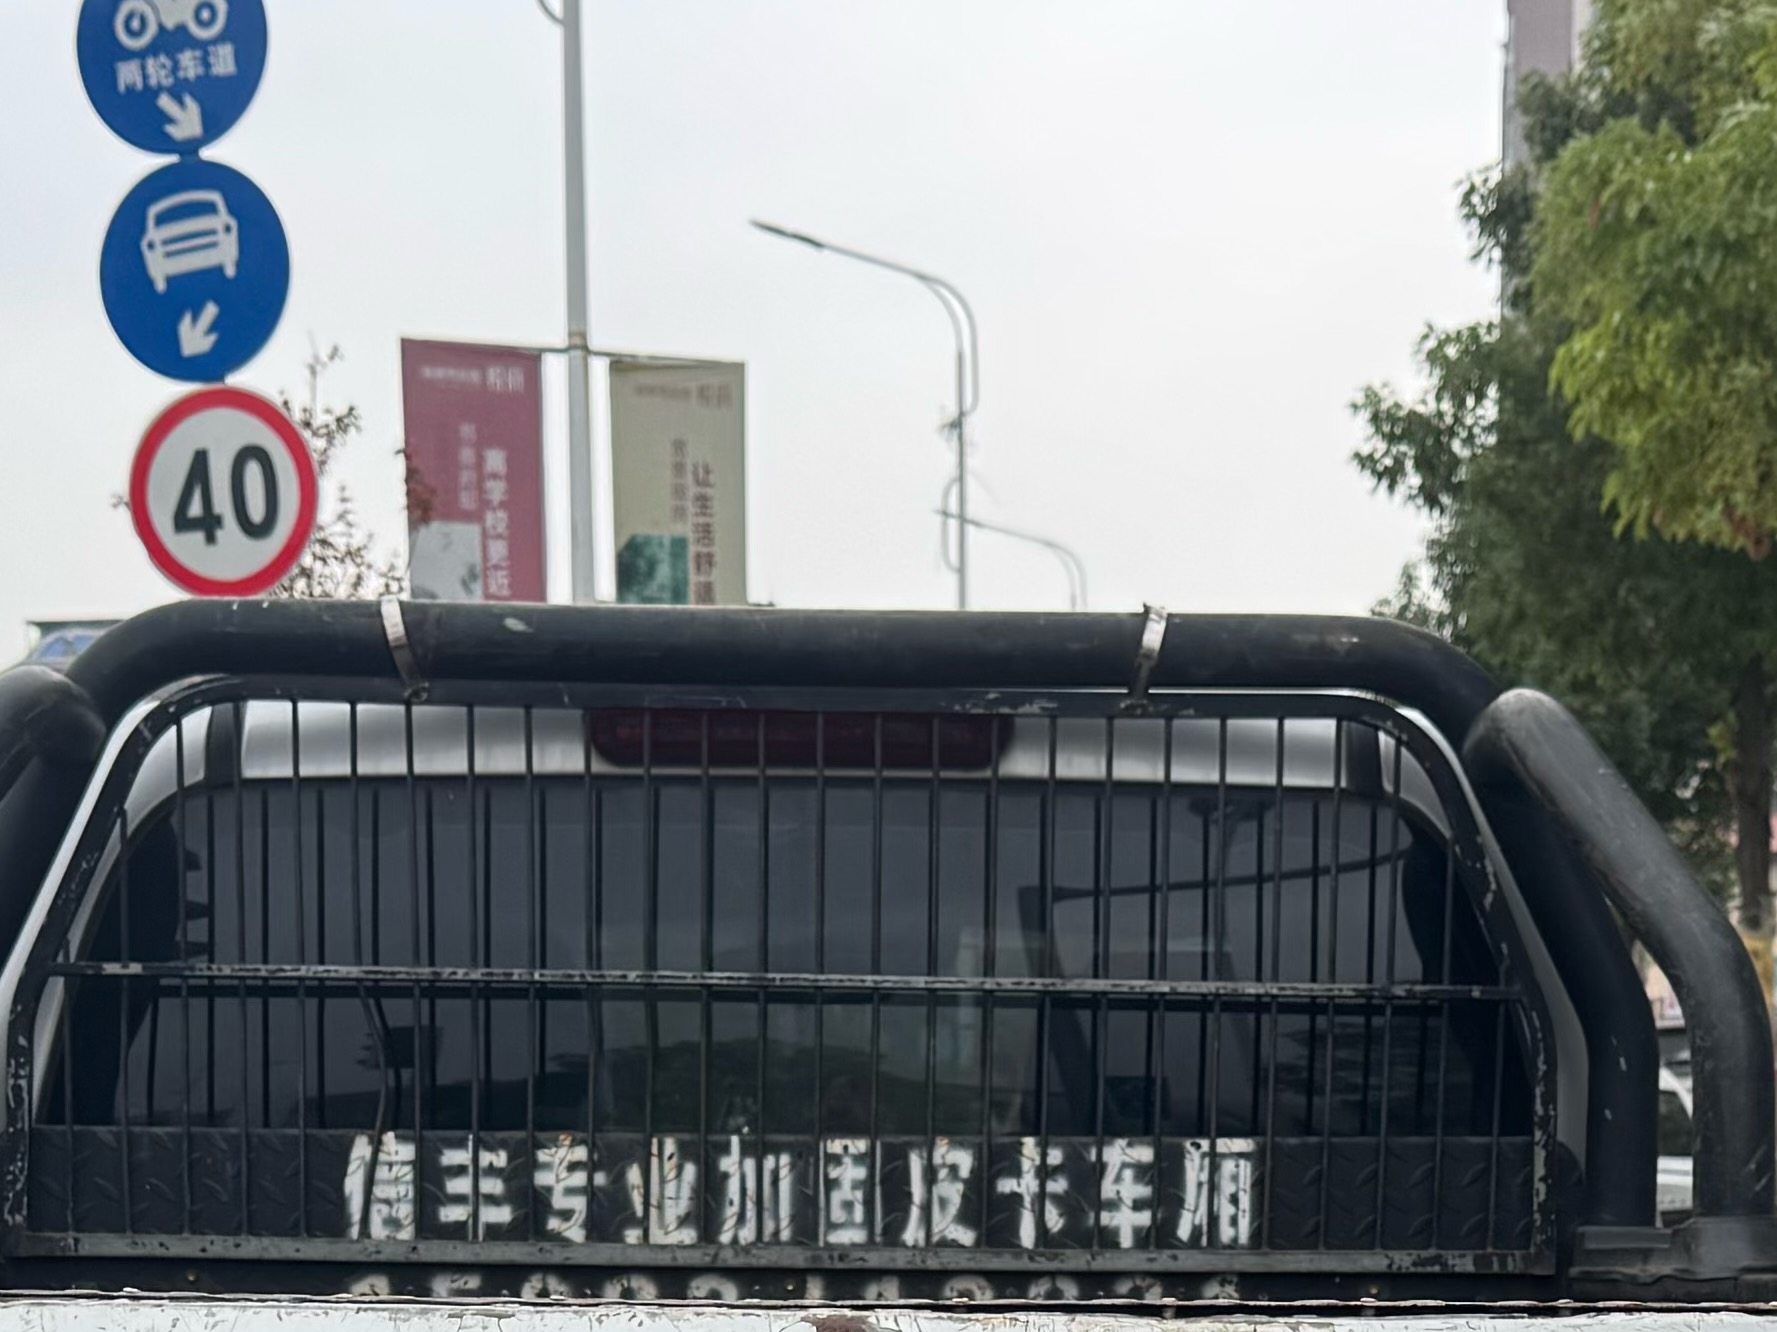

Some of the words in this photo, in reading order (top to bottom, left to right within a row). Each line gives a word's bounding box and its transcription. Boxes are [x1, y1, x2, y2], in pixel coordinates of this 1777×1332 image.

[114, 42, 237, 94] 两轮车道
[173, 443, 280, 546] 40
